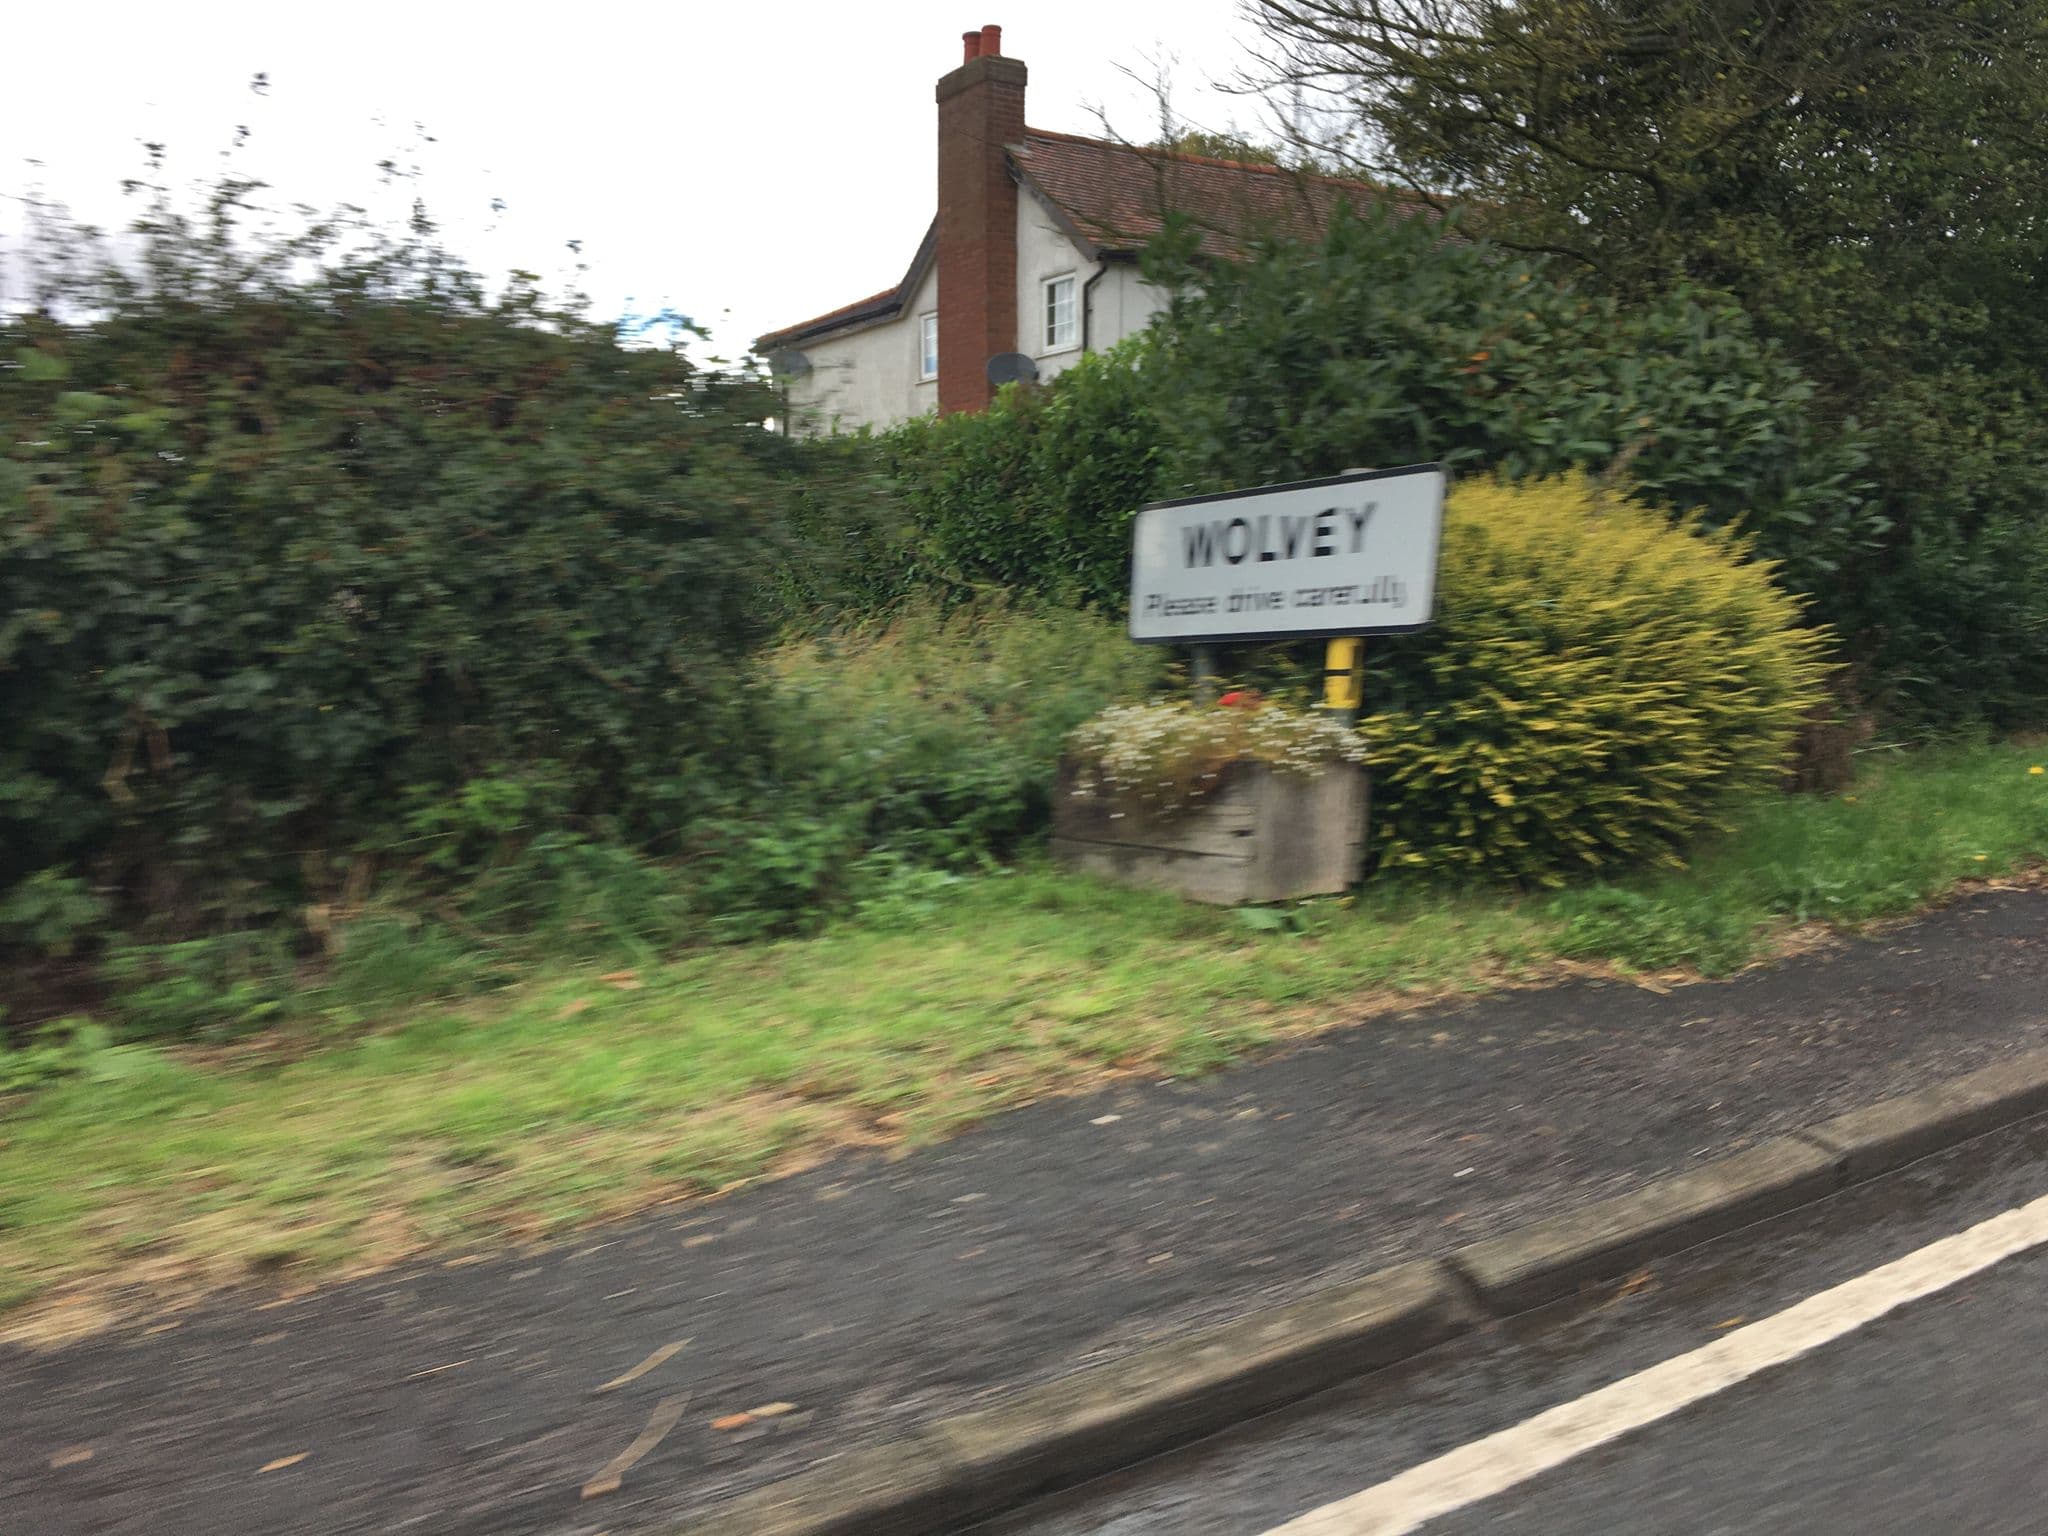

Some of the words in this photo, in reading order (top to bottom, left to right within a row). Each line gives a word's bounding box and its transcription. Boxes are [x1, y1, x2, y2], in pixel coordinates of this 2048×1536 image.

[1182, 502, 1377, 568] WOLVEY
[1143, 591, 1218, 618] Please
[1226, 586, 1285, 614] drive
